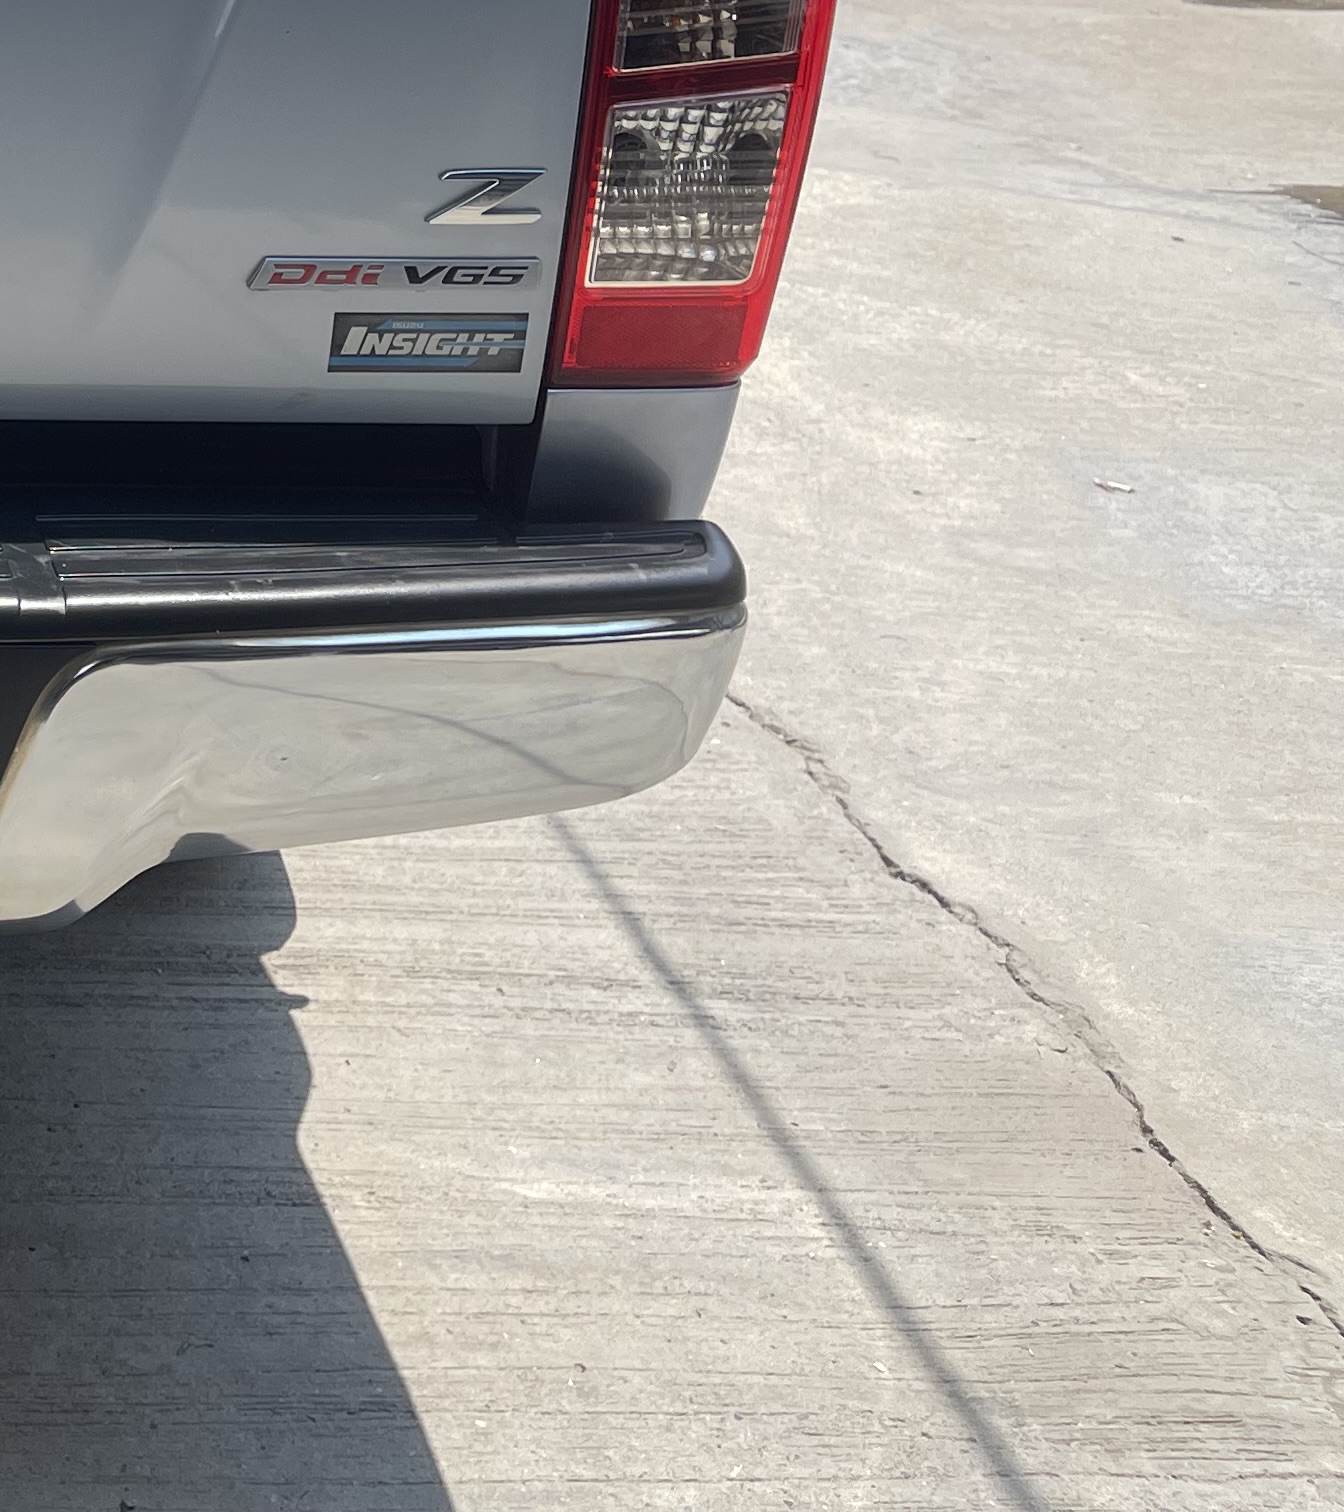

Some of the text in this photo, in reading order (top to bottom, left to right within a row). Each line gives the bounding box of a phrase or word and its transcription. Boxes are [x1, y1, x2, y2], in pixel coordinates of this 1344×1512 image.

[424, 168, 547, 226] Z
[267, 264, 530, 286] Ddi VGS
